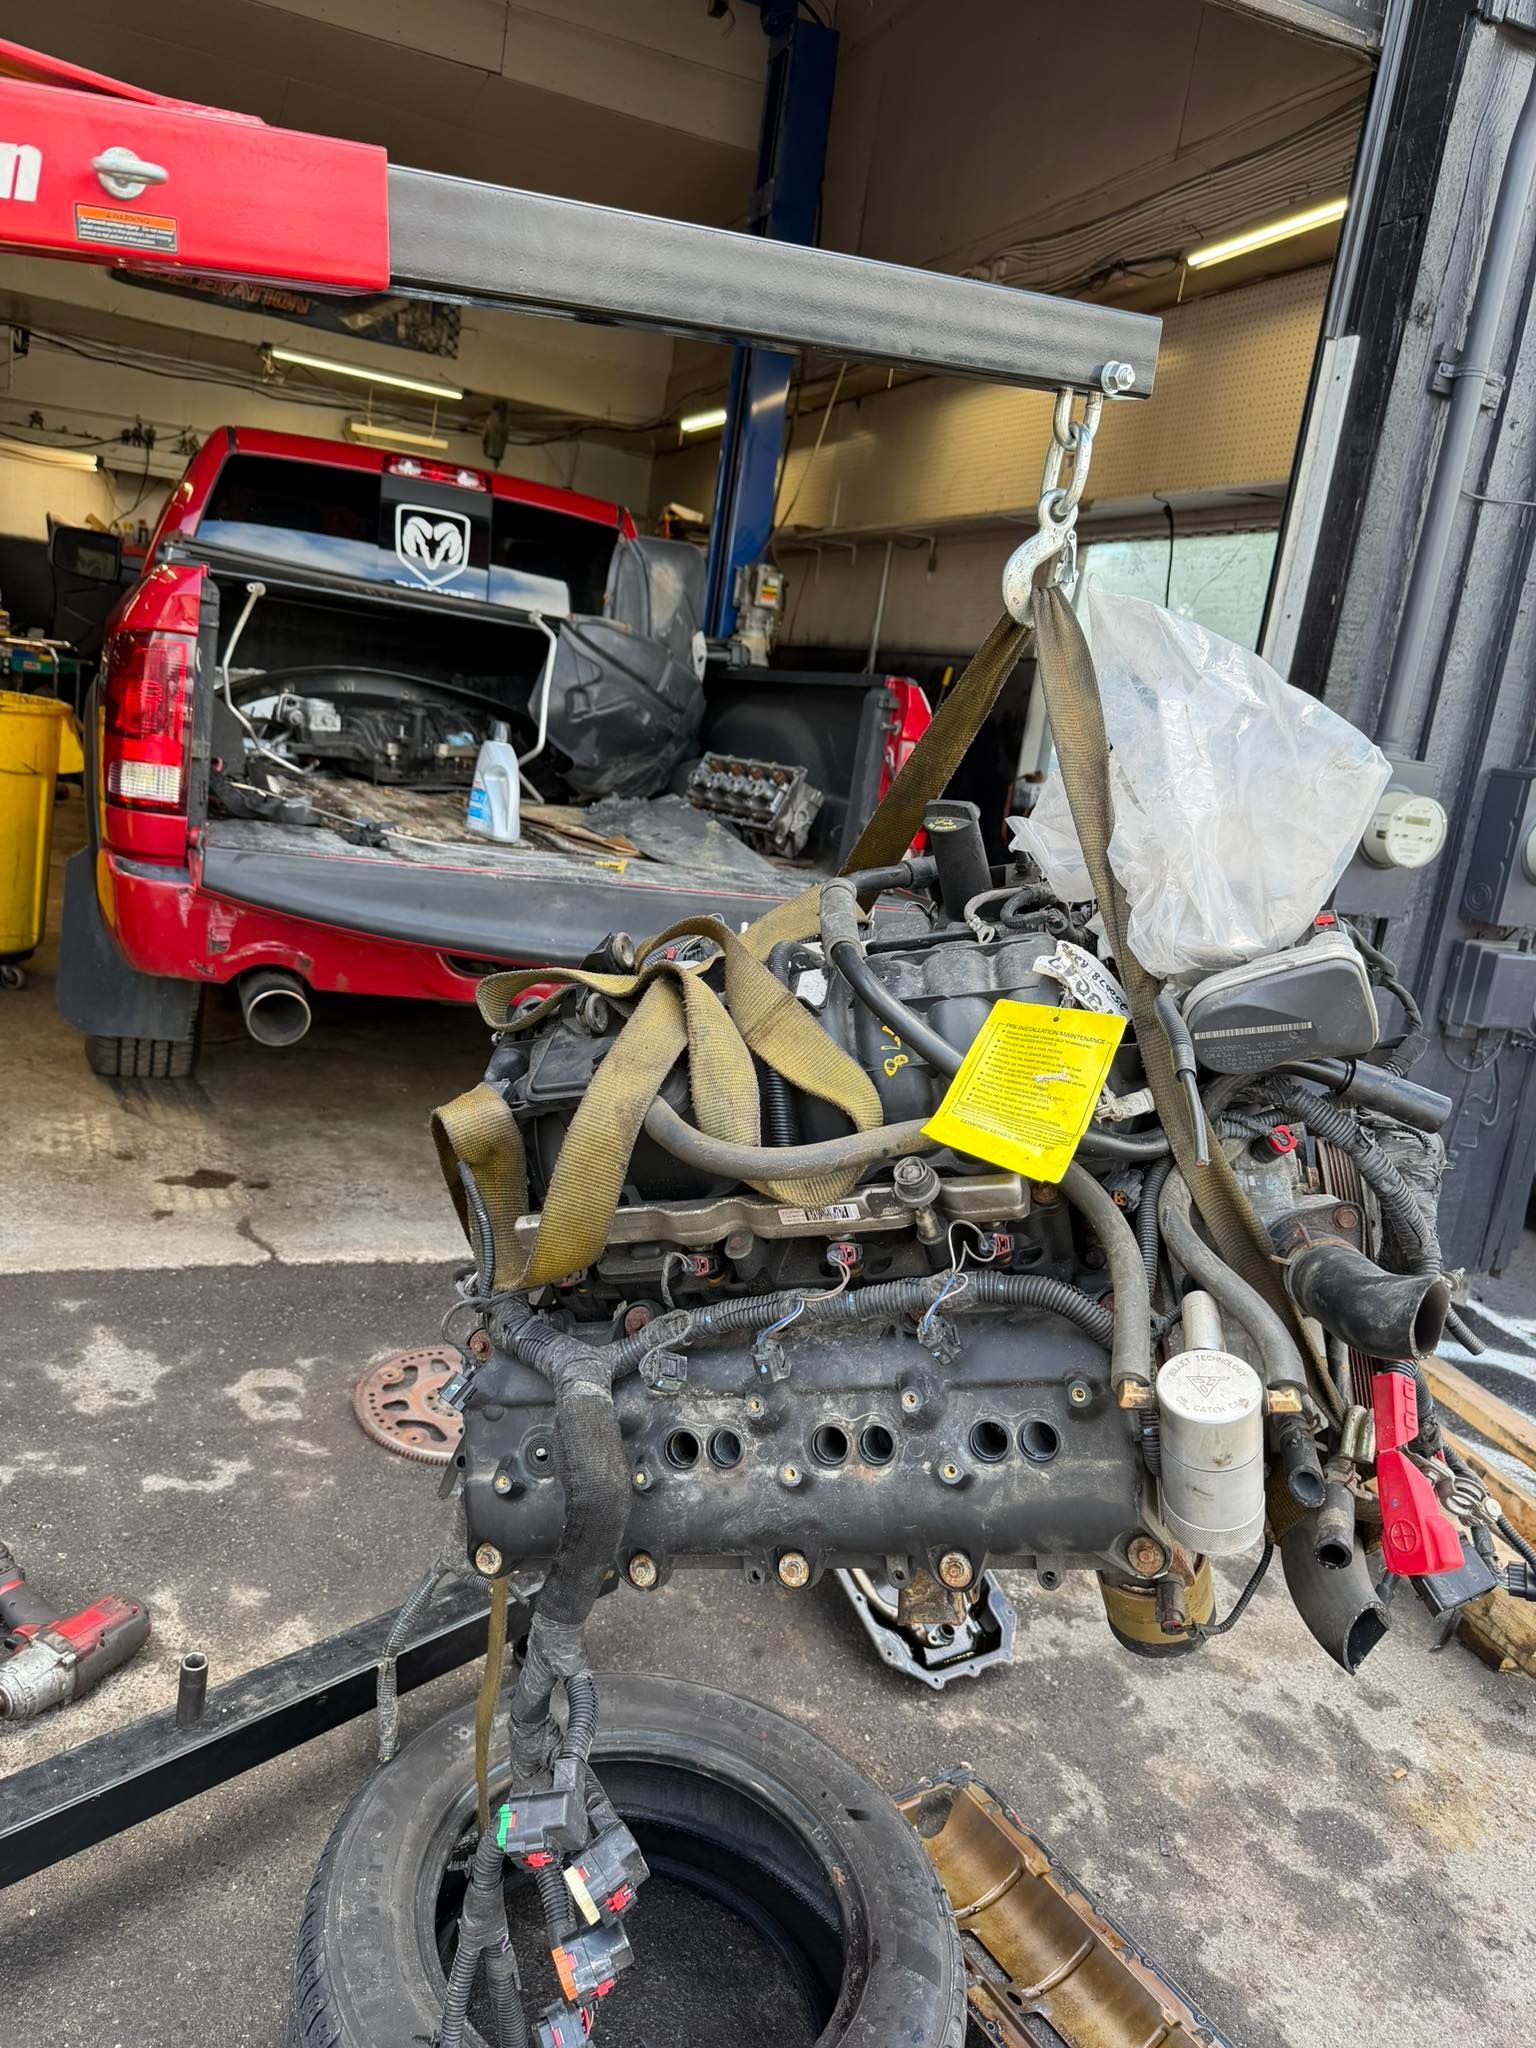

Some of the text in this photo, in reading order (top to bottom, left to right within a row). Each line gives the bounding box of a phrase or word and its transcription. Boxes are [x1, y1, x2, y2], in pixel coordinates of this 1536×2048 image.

[1005, 1023, 1106, 1044] PRE-INSTALLATION MAINTENANCE
[1168, 1354, 1248, 1377] BILLET TECHNOLOGY
[1175, 1394, 1190, 1410] OIL
[1193, 1404, 1226, 1413] CATCH
